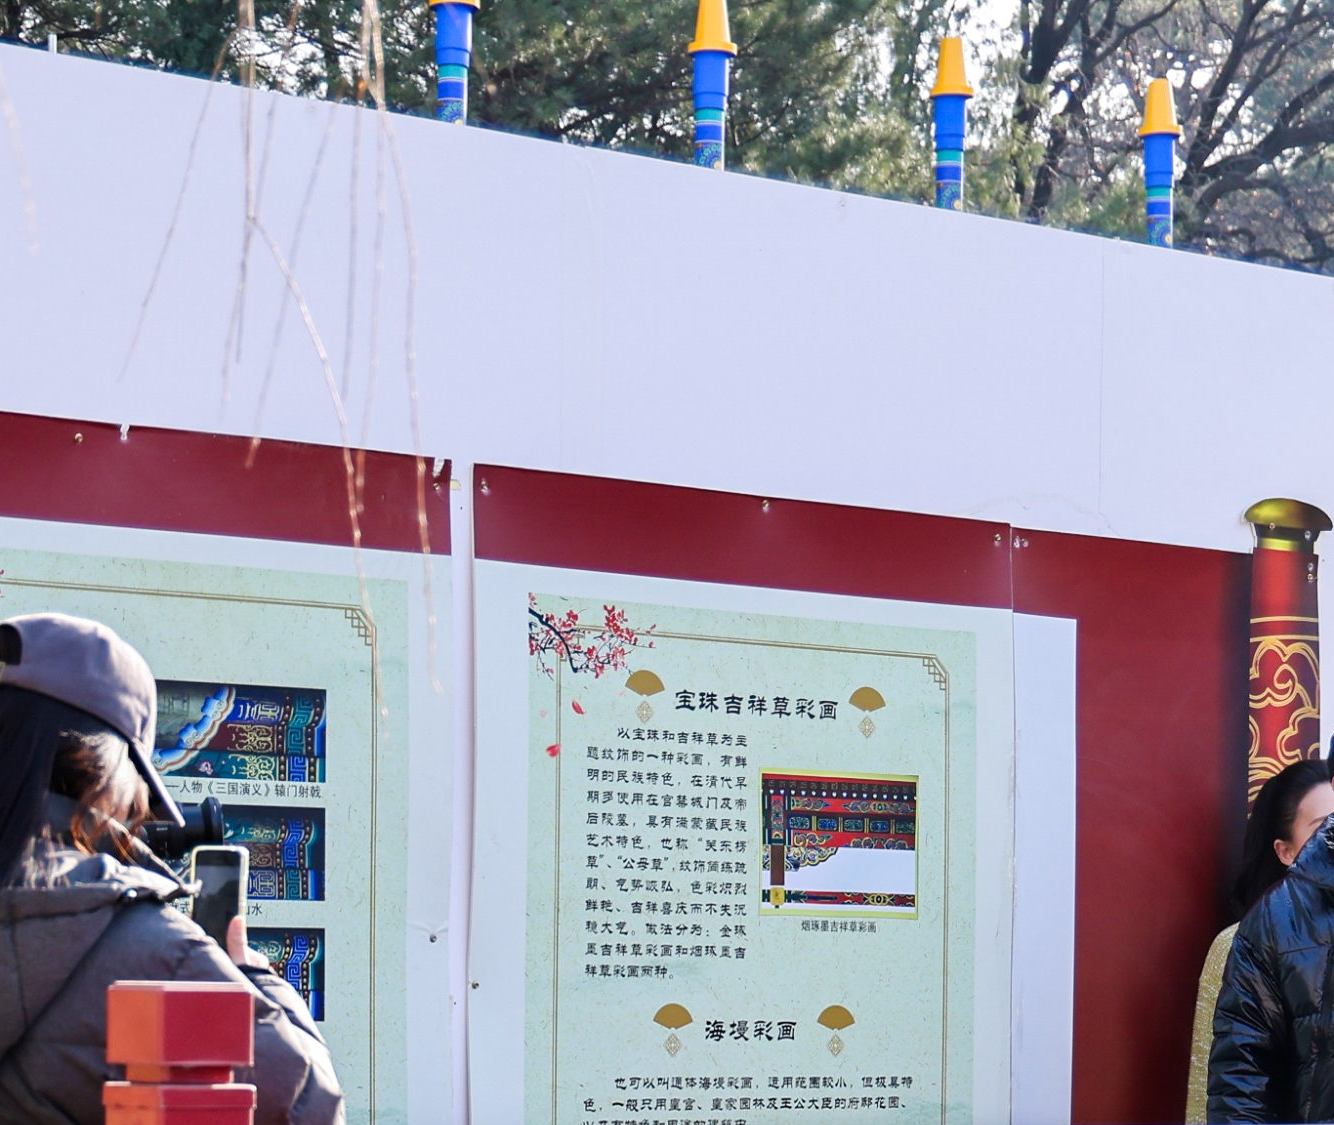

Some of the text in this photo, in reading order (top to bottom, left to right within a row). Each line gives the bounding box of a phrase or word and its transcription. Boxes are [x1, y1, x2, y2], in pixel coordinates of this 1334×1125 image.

[674, 688, 839, 721] 宝珠吉祥草彩画
[617, 727, 748, 748] 以宝珠和吉祥草为主
[586, 746, 748, 769] 题纹饰的一种彩画，有鲜
[586, 768, 748, 791] 明的民族特色，在清代早
[586, 812, 748, 833] 后陵墓，具有满蒙藏民族
[585, 899, 747, 917] 鲜艳、吉祥喜庆而不失沉
[800, 919, 878, 934] 烟琢墨吉祥草彩画
[584, 942, 747, 960] 墨吉祥草彩画和烟琢墨吉
[584, 964, 675, 980] 祥草彩画两种。
[704, 1018, 798, 1043] 海墁彩画
